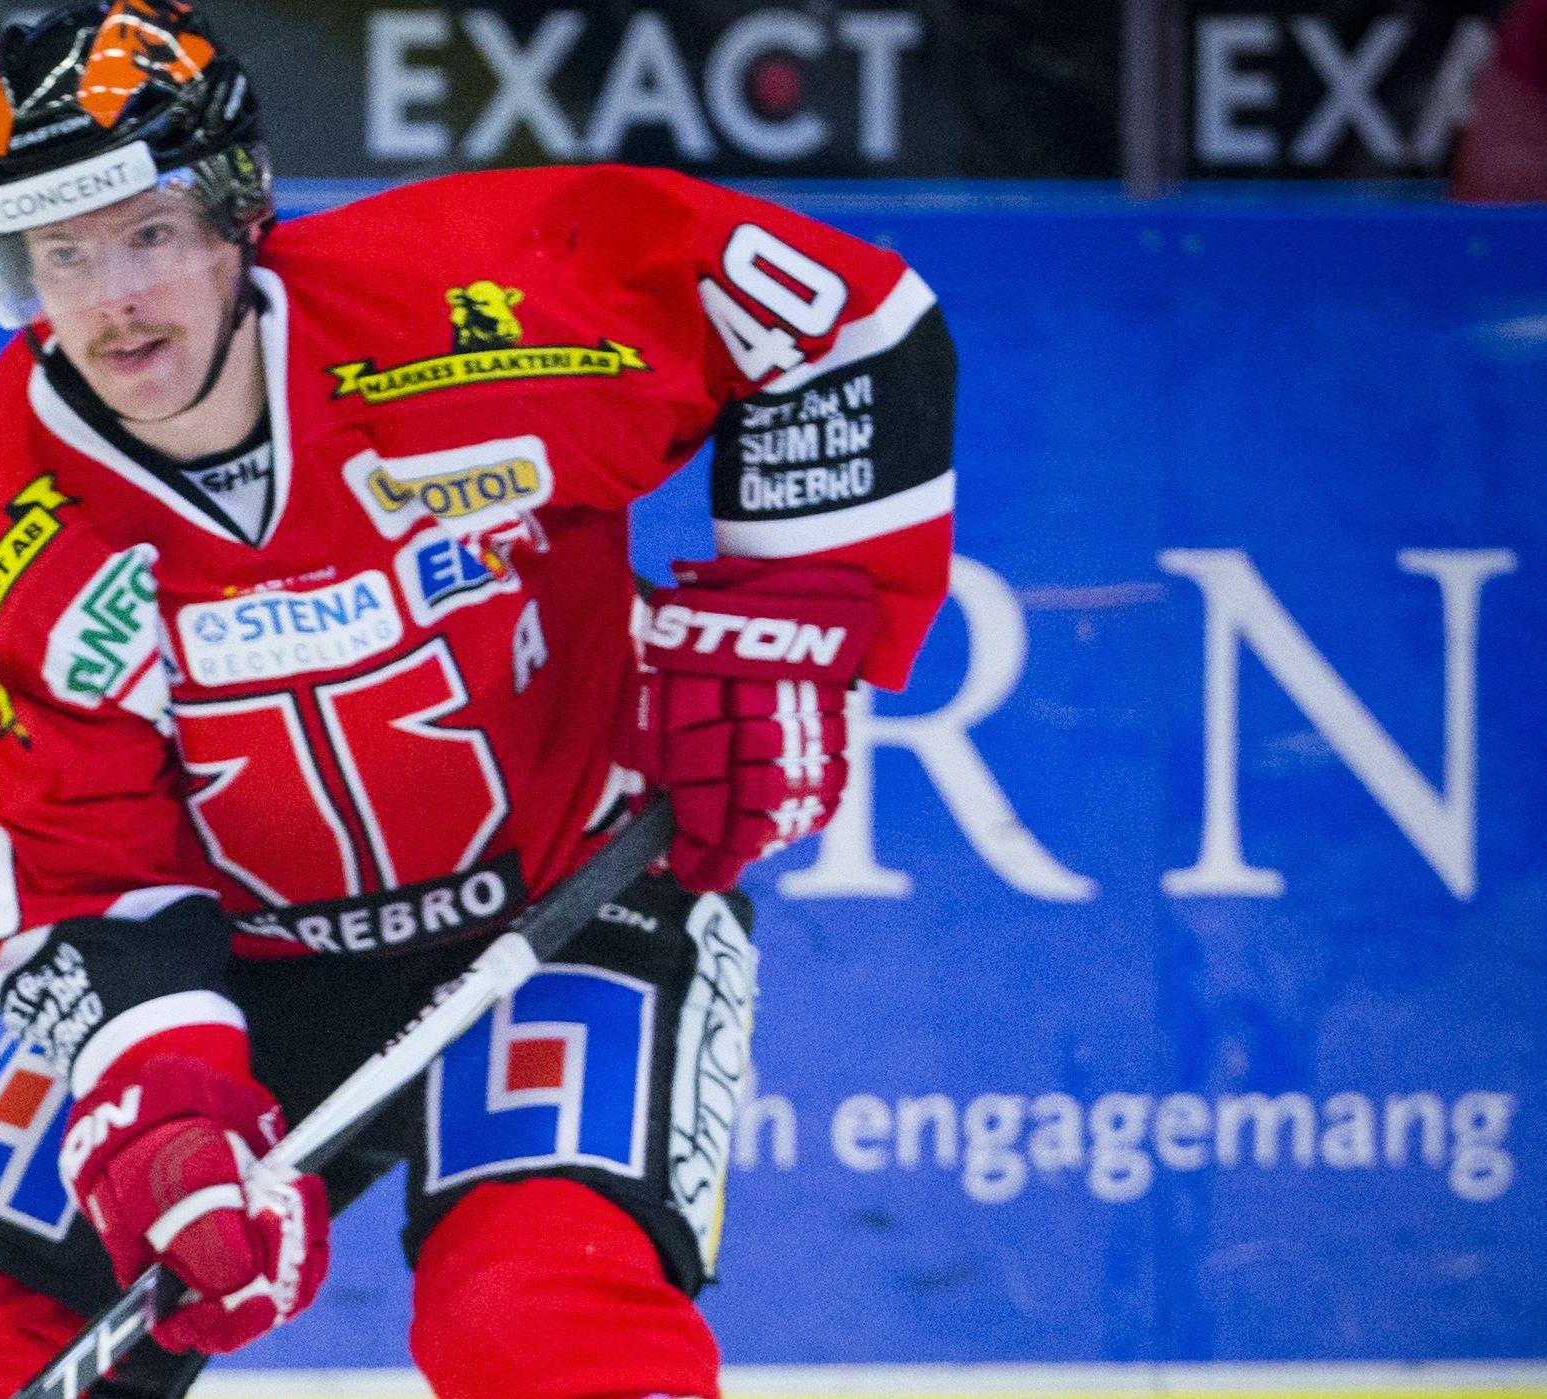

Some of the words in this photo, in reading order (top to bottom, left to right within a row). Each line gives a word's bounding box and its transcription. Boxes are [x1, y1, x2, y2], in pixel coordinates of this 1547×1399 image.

[365, 10, 923, 160] EXACT
[2, 161, 130, 220] CONCENT
[697, 222, 849, 383] 40
[234, 582, 380, 641] STENA
[629, 598, 848, 667] STON
[831, 1091, 1517, 1204] engagemang
